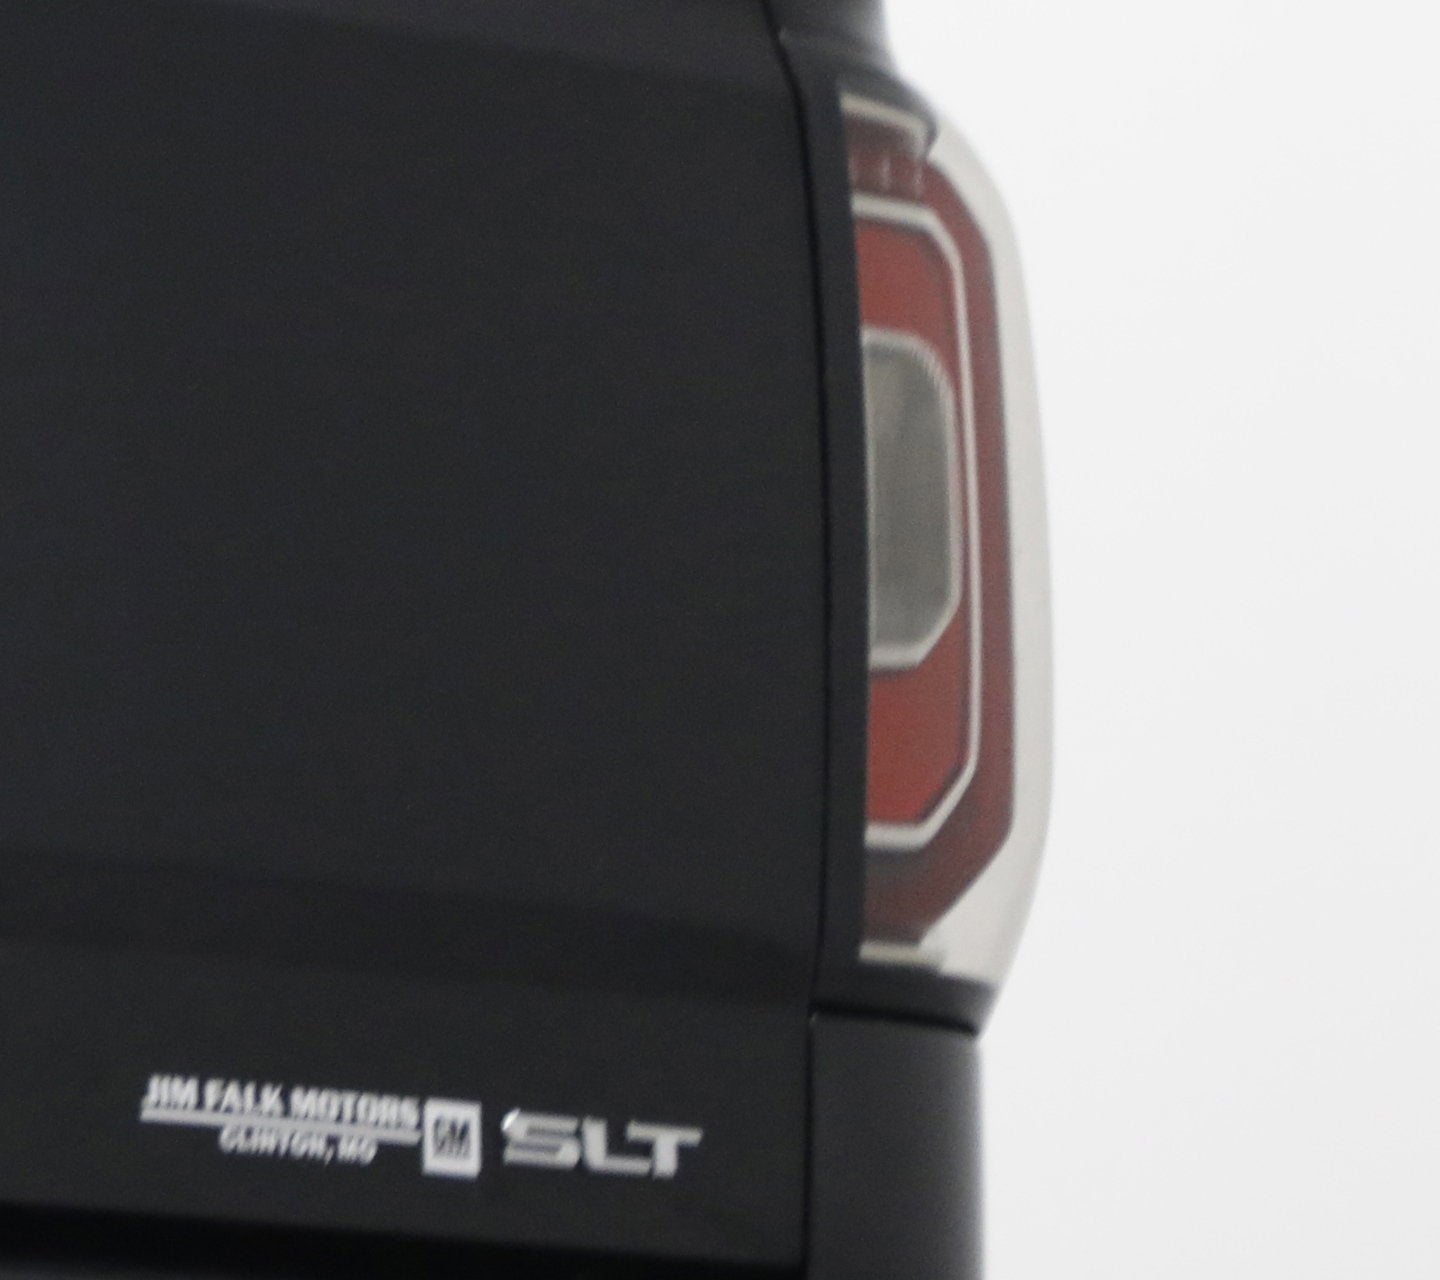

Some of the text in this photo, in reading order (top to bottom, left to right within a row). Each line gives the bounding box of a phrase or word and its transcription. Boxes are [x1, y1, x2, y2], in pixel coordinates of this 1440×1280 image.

[143, 1072, 420, 1131] JIM FALK MOTORS
[502, 1107, 704, 1178] SLT
